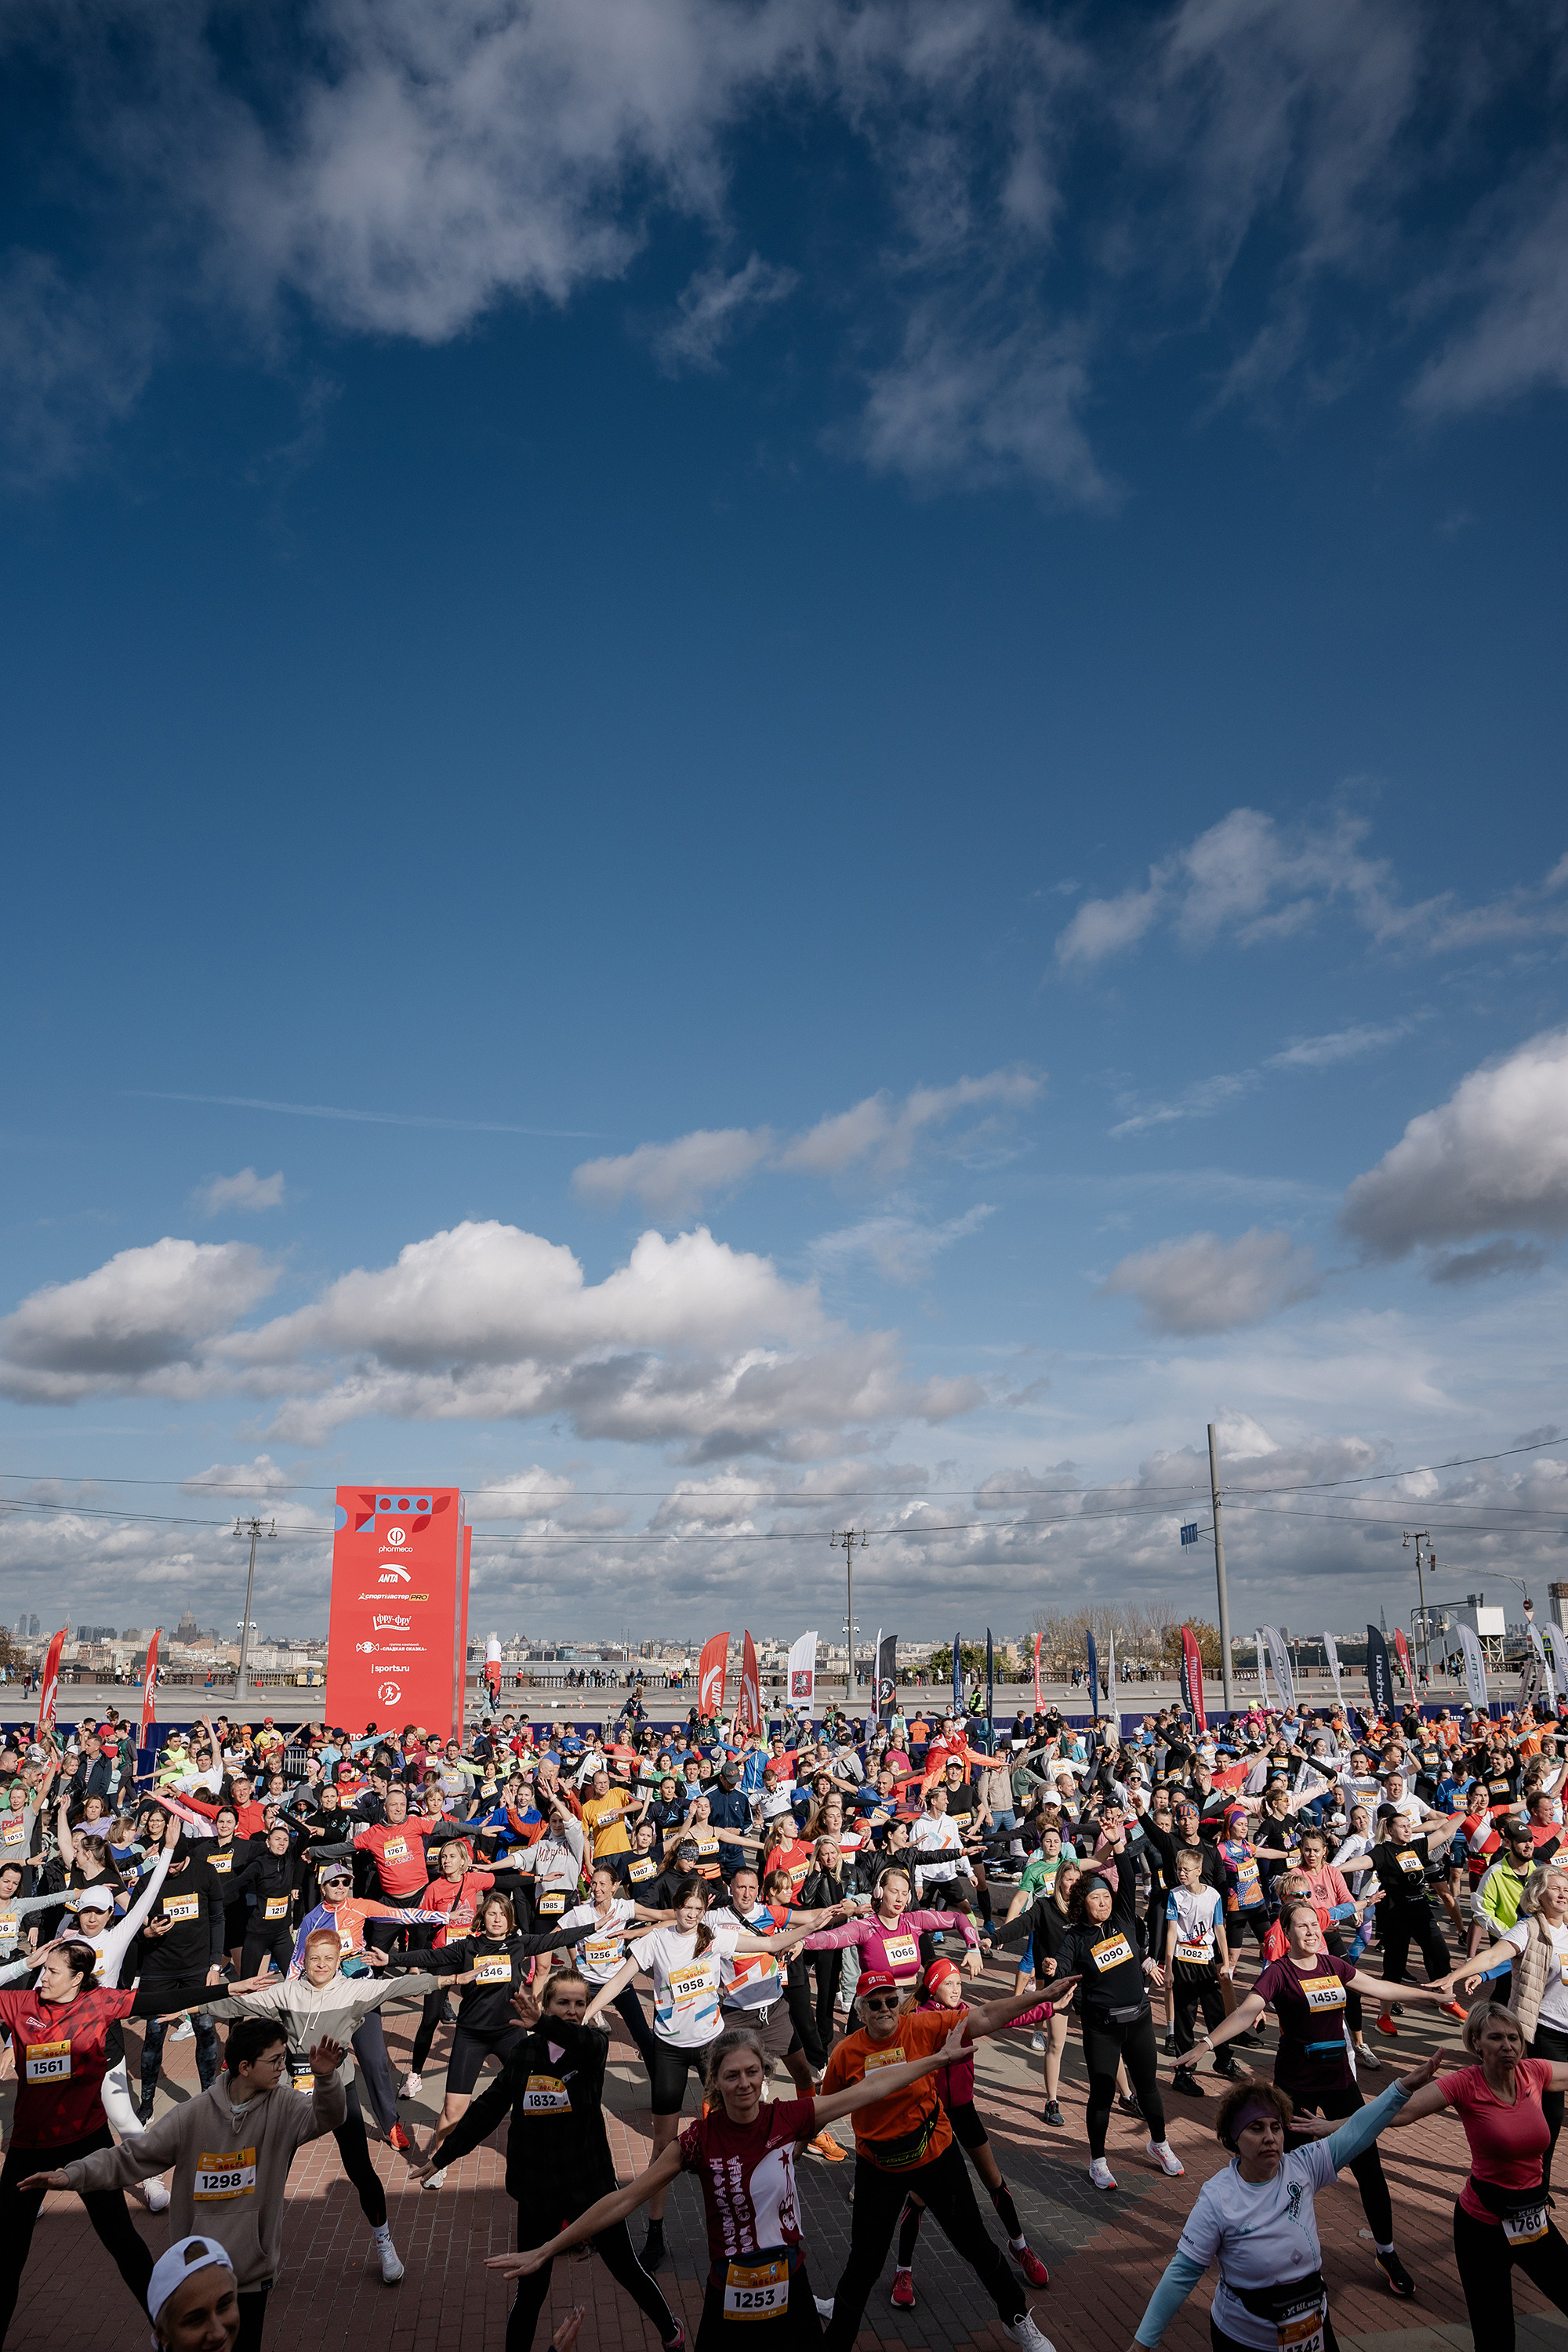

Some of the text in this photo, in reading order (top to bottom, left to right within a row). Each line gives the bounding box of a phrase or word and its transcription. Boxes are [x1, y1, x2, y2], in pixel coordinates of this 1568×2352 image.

[378, 1545, 413, 1554] pharmeco
[378, 1573, 399, 1583] ANTA
[375, 1664, 410, 1674] sports.ru
[711, 1681, 722, 1708] ANTA
[7, 1833, 24, 1842] 1055
[387, 1846, 404, 1856] 1767
[536, 1845, 569, 1862] MICHAN
[633, 1867, 648, 1877] 1987
[1243, 1868, 1254, 1877] 1115
[169, 1906, 189, 1916] 1931
[590, 1951, 611, 1959] 1256
[891, 1947, 914, 1958] 1066
[1098, 1947, 1123, 1964] 1090
[1182, 1949, 1203, 1958] 1082
[677, 1978, 705, 1994] 1958
[1312, 1991, 1338, 2003] 1455
[33, 2060, 63, 2074] 1561
[529, 2095, 557, 2107] 1832
[202, 2173, 241, 2189] 1298
[1509, 2214, 1541, 2233] 1760
[734, 2288, 775, 2308] 1253
